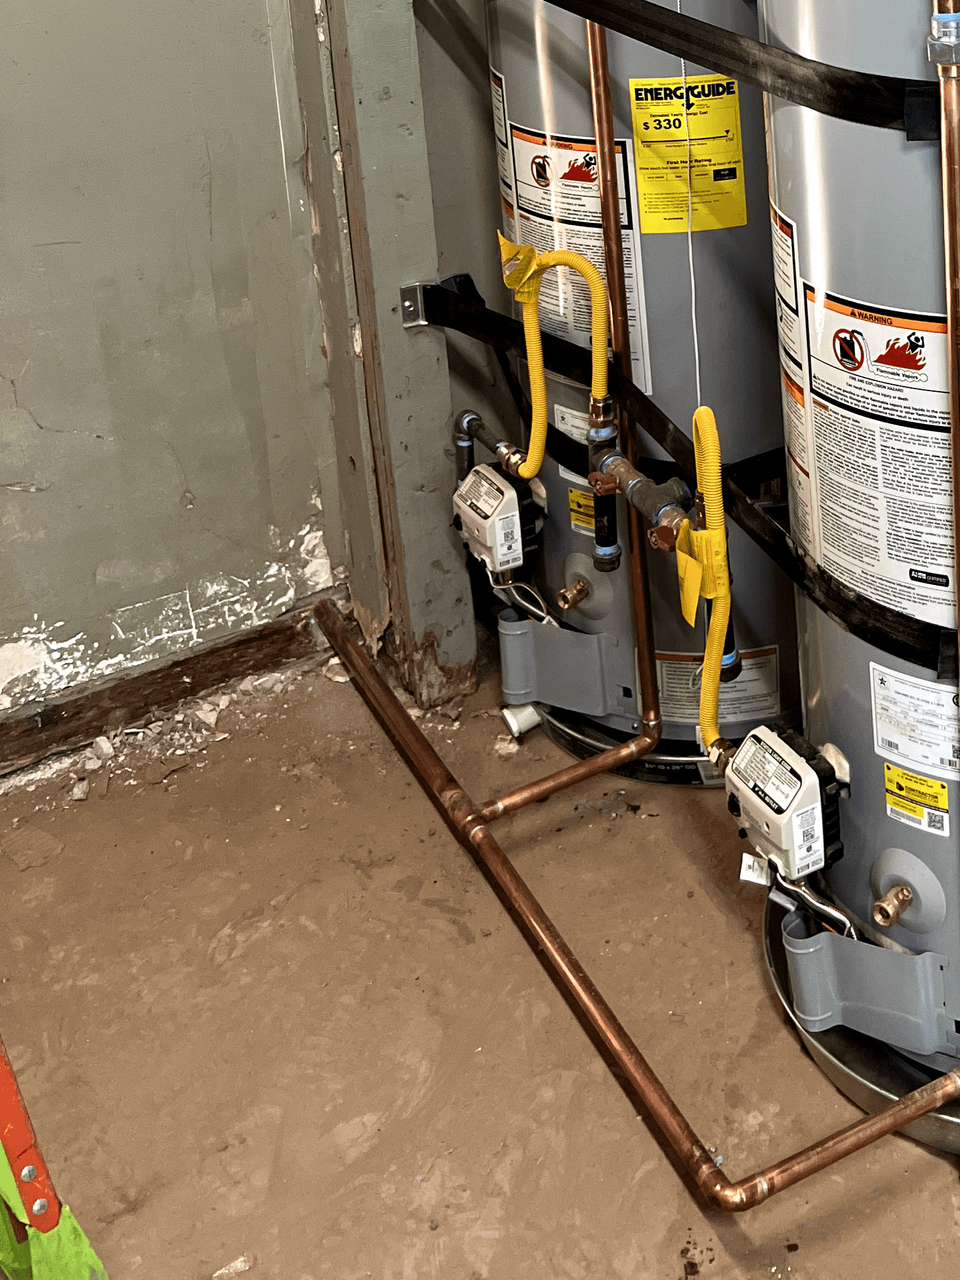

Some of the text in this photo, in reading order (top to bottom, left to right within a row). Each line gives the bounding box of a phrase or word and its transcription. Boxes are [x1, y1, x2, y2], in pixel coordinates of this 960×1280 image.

[635, 81, 736, 101] ENERGYGUIDE
[653, 118, 681, 130] 330
[857, 311, 893, 325] WARNING
